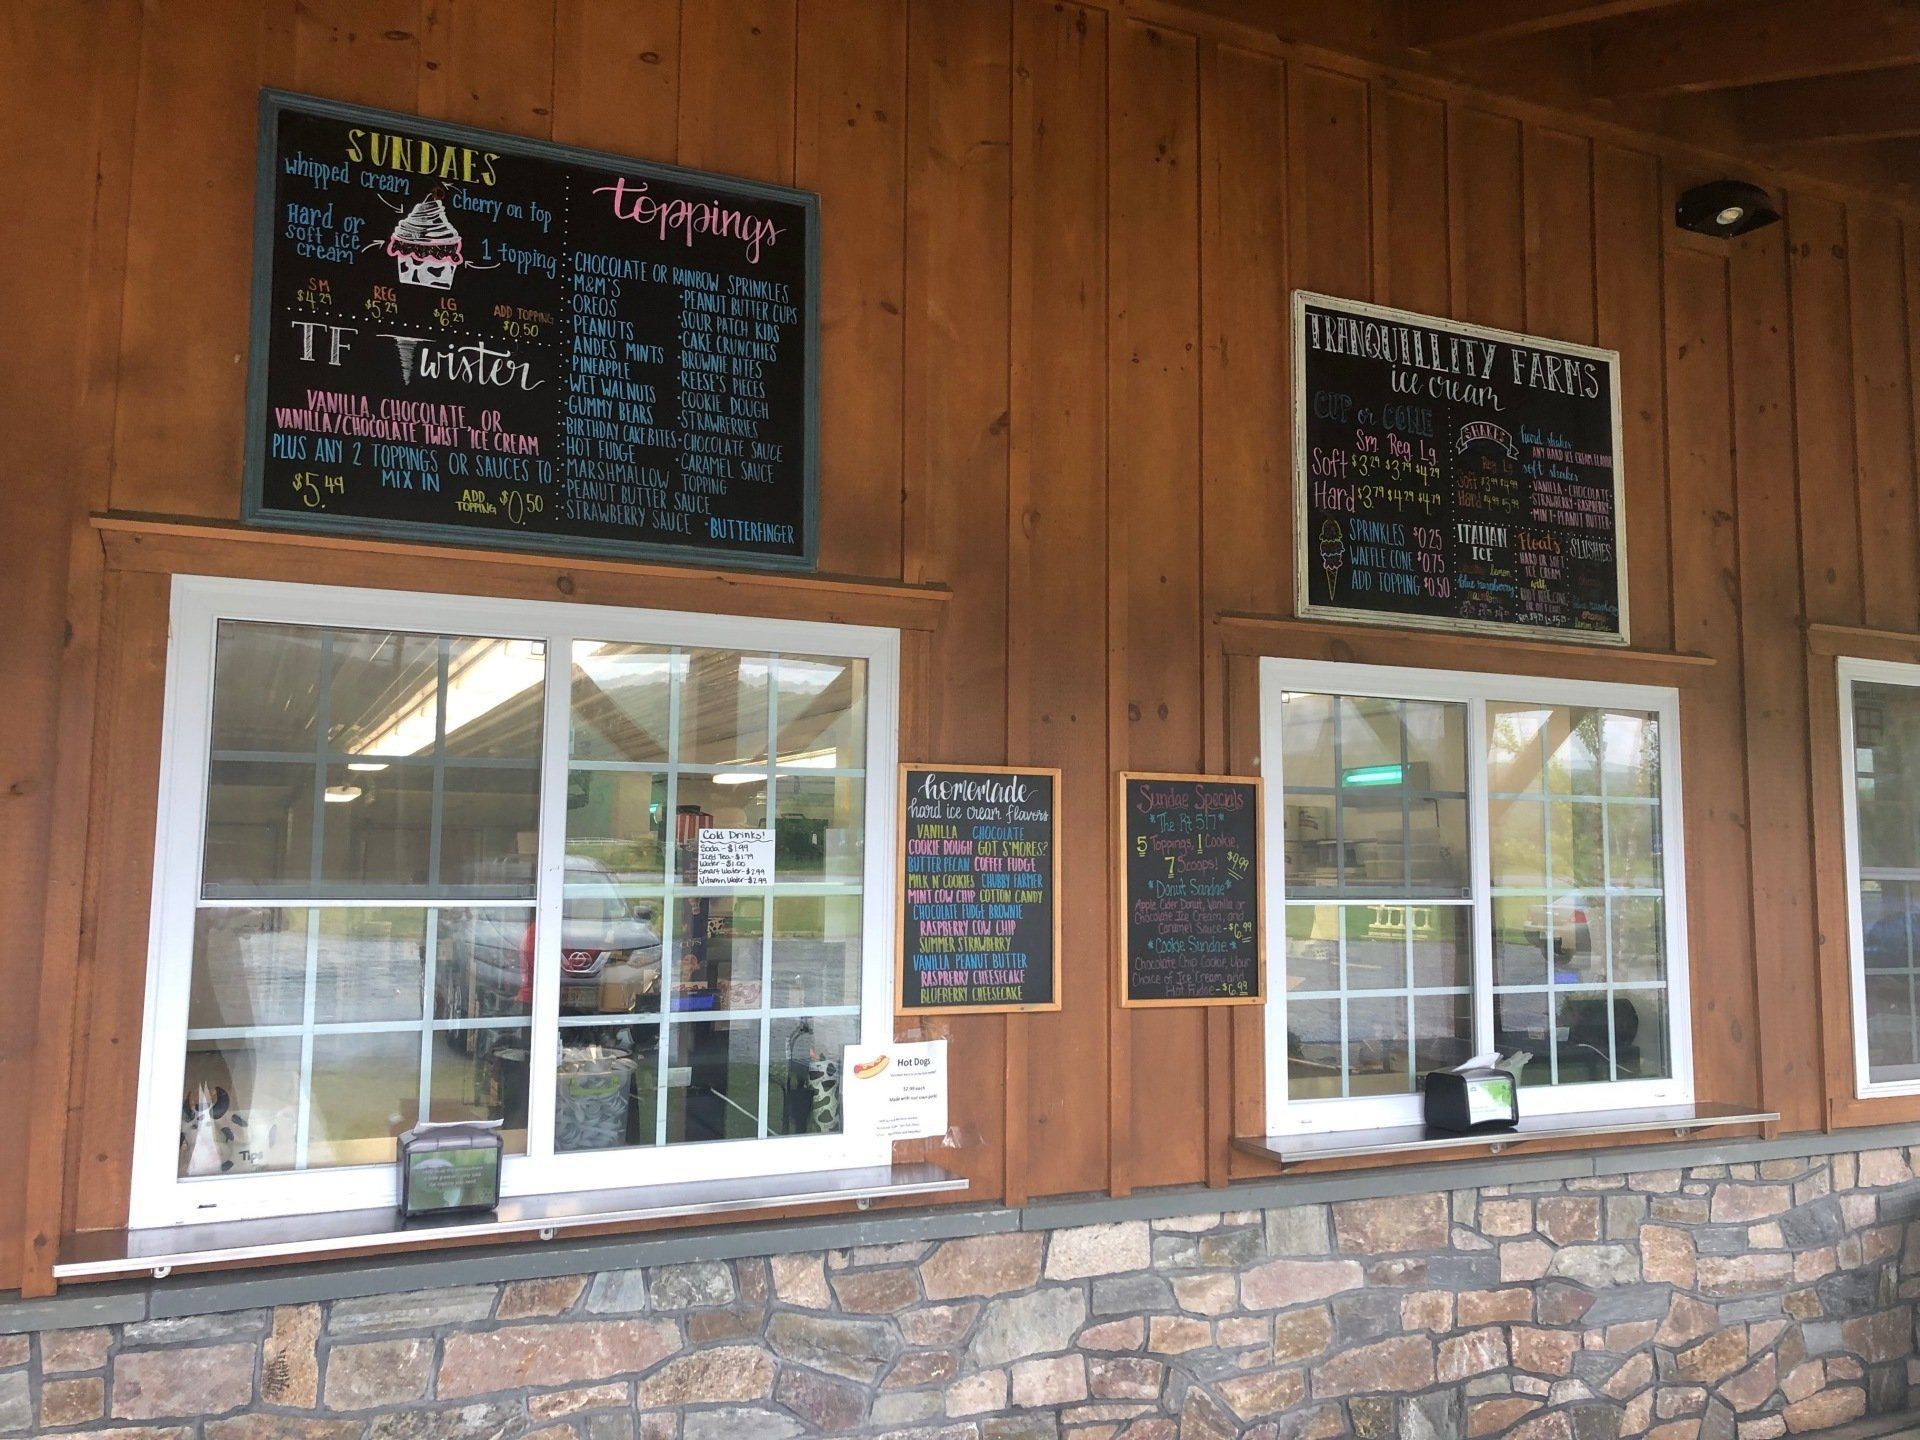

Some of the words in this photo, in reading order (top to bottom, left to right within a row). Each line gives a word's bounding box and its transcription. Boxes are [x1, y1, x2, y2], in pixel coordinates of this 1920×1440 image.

[346, 129, 500, 186] SUNDAES
[285, 152, 350, 190] whipped
[360, 170, 410, 195] cream
[288, 203, 333, 228] Hard
[344, 216, 365, 234] or
[452, 189, 501, 222] cherry
[507, 203, 522, 218] on
[530, 202, 552, 232] top
[592, 178, 787, 264] toppings
[285, 224, 323, 244] soft
[335, 232, 360, 250] ice
[297, 242, 354, 264] cream
[481, 238, 492, 262] 1
[498, 242, 557, 279] topping
[309, 278, 330, 292] SM
[574, 273, 621, 298] M&M'S
[575, 252, 647, 282] CHOCOLATE
[653, 264, 667, 283] OR
[672, 267, 719, 291] RAINBOW
[728, 275, 789, 304] SPRINKLES
[373, 286, 396, 302] REG
[441, 298, 456, 310] LG
[573, 295, 617, 318] OREOS
[494, 305, 513, 318] ADD
[517, 308, 554, 325] TOPPING
[684, 290, 726, 315] PEANUT
[731, 299, 769, 322] BUTTER
[773, 304, 798, 325] CUPS
[503, 321, 539, 338] $0.50
[681, 311, 712, 333] SOUR
[717, 317, 748, 338] PATCH
[755, 322, 780, 343] KIDS
[292, 322, 358, 366] TF
[376, 334, 545, 390] Twister
[574, 336, 616, 359] ANDES
[626, 343, 664, 365] MINTS
[1306, 312, 1496, 379] TRANQUILLITY
[1512, 349, 1599, 399] FARMS
[569, 374, 596, 394] WET
[601, 380, 657, 404] WALNUTS
[1391, 366, 1424, 395] ice
[1428, 376, 1506, 412] cream
[307, 389, 376, 420] VANILLA,
[380, 398, 471, 431] CHOCOLATE,
[481, 410, 503, 432] OR
[1314, 390, 1352, 423] CUP
[1357, 407, 1376, 425] or
[275, 408, 417, 442] VANILLA/CHOCOLATE
[422, 424, 459, 447] TWIST
[470, 428, 490, 450] ICE
[494, 432, 540, 456] CREAM
[681, 411, 758, 439] STRAWBERRIES
[1465, 424, 1505, 442] SHAKES
[272, 434, 307, 460] PLUS
[315, 438, 343, 463] ANY
[353, 442, 362, 466] 2
[371, 444, 438, 473] TOPPINGS
[449, 454, 468, 475] OR
[476, 455, 530, 482] SAUCES
[537, 459, 552, 483] TO
[683, 432, 744, 457] CHOCOLATE
[751, 442, 783, 462] SAUCE
[1312, 447, 1348, 478] Soft
[292, 473, 344, 508] $5.49
[382, 471, 412, 489] MIX
[422, 472, 440, 492] IN
[456, 501, 497, 515] TOPPING
[463, 489, 485, 502] ADD
[500, 490, 544, 525] $0.50
[1314, 481, 1355, 513] Hard
[710, 517, 795, 544] BUTTERFINGER
[1350, 517, 1405, 547] SPRINKLES
[1413, 526, 1443, 550] $0.25
[1458, 524, 1508, 547] ITALIAN
[1472, 546, 1493, 561] ICE
[1519, 532, 1561, 555] Floats
[1570, 538, 1612, 561] SLUSHIES
[1350, 545, 1387, 568] WAFFLE
[1390, 550, 1414, 572] CONE
[1417, 551, 1445, 573] $0.75
[1490, 565, 1511, 576] lemon
[1352, 570, 1372, 591] ADD
[1379, 572, 1420, 596] TOPPING
[1424, 576, 1450, 598] $0.50
[918, 774, 1038, 803] homemade
[1136, 784, 1189, 814] Sundae
[1195, 785, 1244, 814] Specials
[908, 798, 941, 819] hard
[946, 802, 962, 819] ice
[966, 805, 1001, 820] cream
[1006, 804, 1049, 824] flavors
[1157, 811, 1175, 832] The
[1180, 813, 1192, 834] Rt
[1196, 814, 1216, 830] 517
[703, 830, 724, 839] Cold
[729, 831, 765, 839] Drinks!
[917, 824, 958, 838] VANILLA
[972, 826, 1024, 841] CHOCOLATE
[1137, 836, 1147, 851] 5
[1151, 835, 1194, 856] Toppings,
[1197, 834, 1202, 850] 1
[1205, 834, 1239, 849] Cookie,
[908, 839, 940, 855] COOKIE
[943, 839, 972, 855] DOUGH
[978, 841, 998, 856] GOT
[1003, 841, 1048, 857] S'MORES?
[908, 857, 941, 872] BUTTER
[944, 857, 969, 872] PECAN
[974, 857, 1002, 872] COFFEE
[1008, 857, 1036, 872] FUDGE
[1165, 857, 1175, 874] 7
[1178, 856, 1218, 877] Scoops!
[1226, 851, 1249, 871] $9.99
[908, 874, 928, 888] MILK
[932, 875, 941, 888] N'
[943, 874, 975, 888] COOKIES
[982, 874, 1010, 887] CHUBBY
[1013, 874, 1043, 887] FARMER
[1156, 878, 1186, 899] Donut
[920, 920, 968, 936] RASPBERRY
[972, 921, 992, 935] COW
[996, 921, 1016, 935] CHIP
[920, 937, 955, 953] SUMMER
[958, 937, 1011, 952] STRAWBERRY
[913, 955, 949, 971] VANILLA
[956, 954, 988, 969] PEANUT
[993, 954, 1028, 969] BUTTER
[898, 1059, 912, 1067] Hot
[914, 1058, 930, 1067] Dogs
[239, 1150, 263, 1163] Tips
